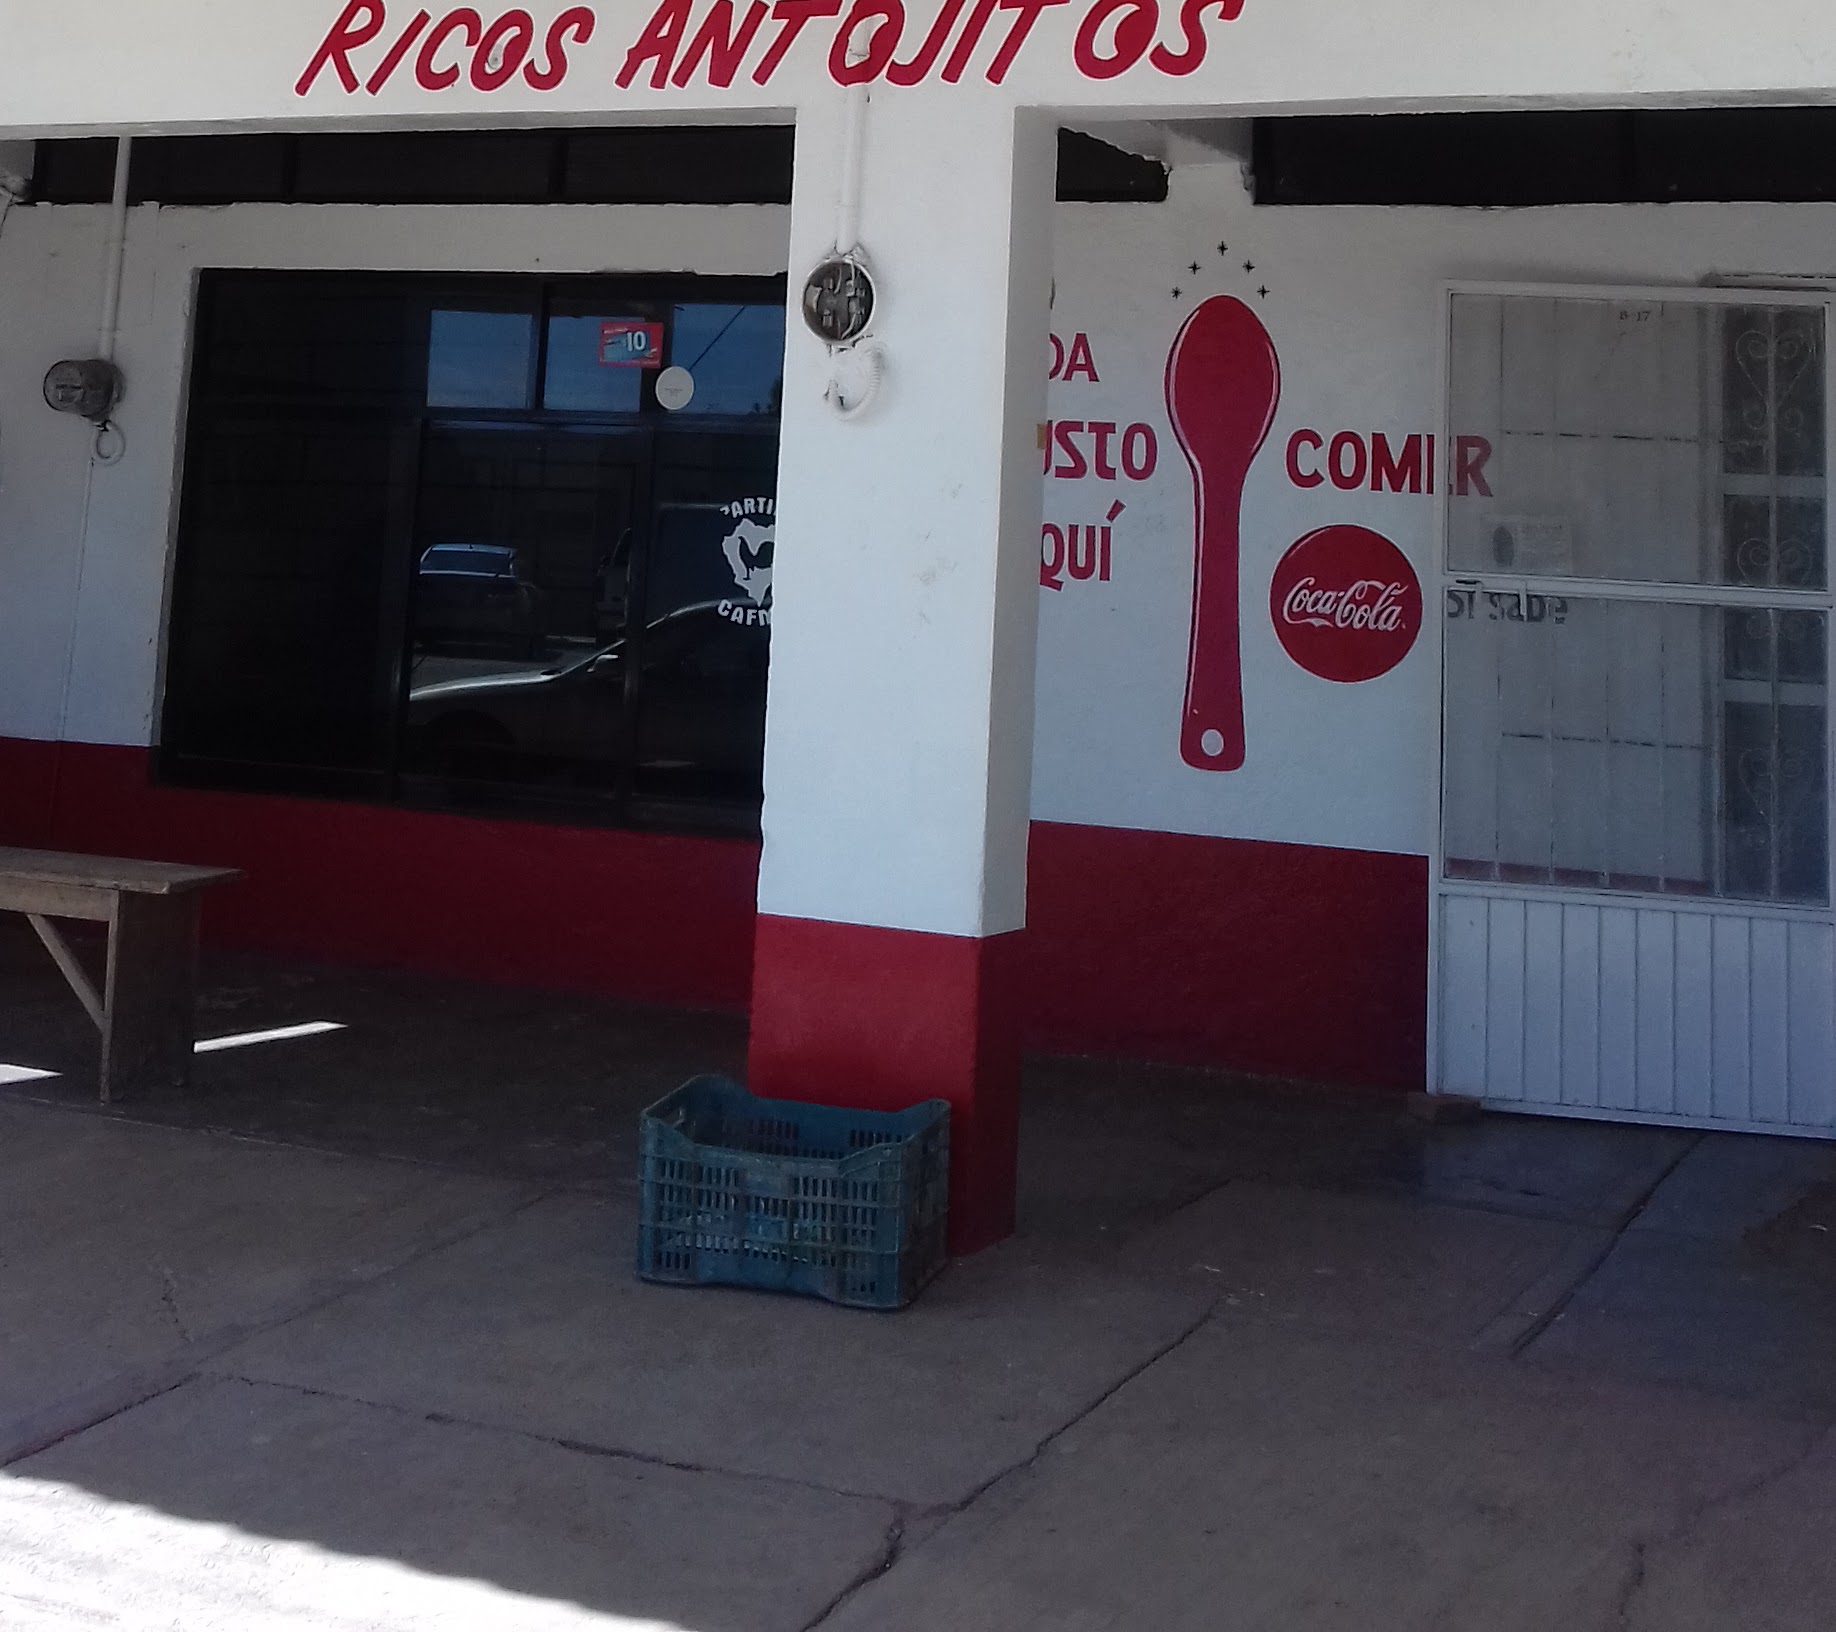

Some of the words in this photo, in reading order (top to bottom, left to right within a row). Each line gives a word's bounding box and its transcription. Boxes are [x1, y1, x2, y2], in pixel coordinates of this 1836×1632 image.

[626, 330, 647, 352] 10
[1043, 419, 1158, 481] STO
[1283, 576, 1409, 632] Coca-Cola
